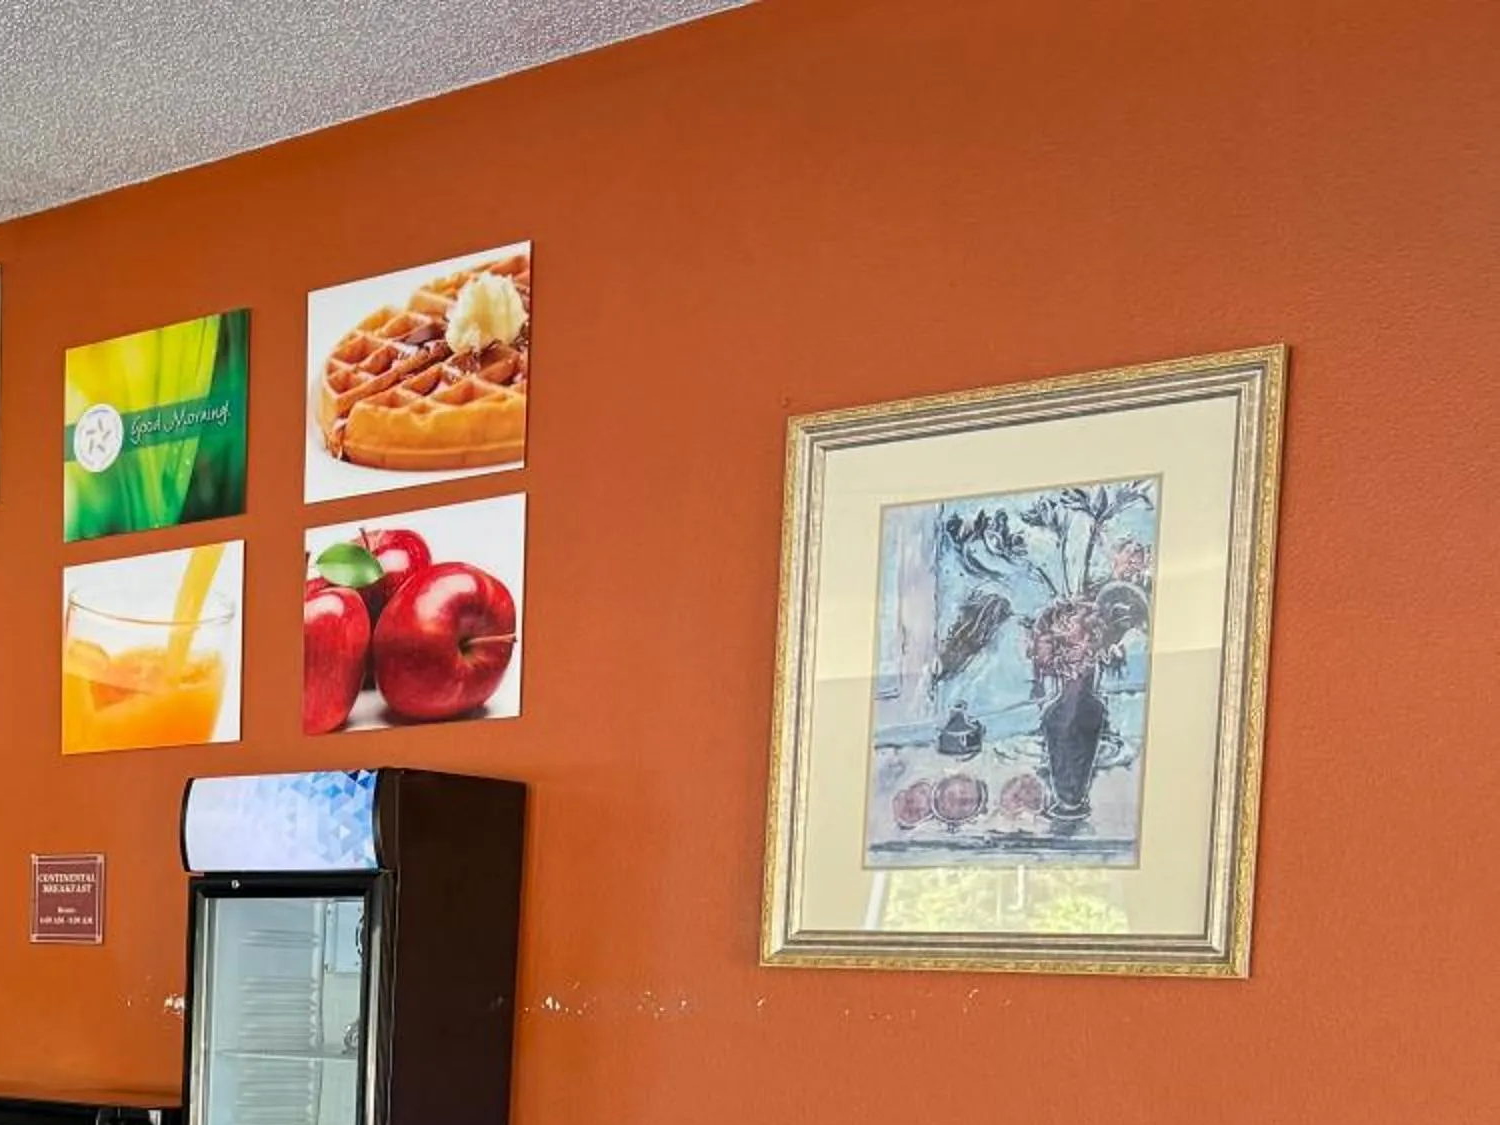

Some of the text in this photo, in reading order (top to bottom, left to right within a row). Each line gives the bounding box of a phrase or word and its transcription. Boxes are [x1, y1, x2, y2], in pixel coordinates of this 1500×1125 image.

[130, 412, 161, 445] Good
[39, 873, 96, 882] CONTINENTAL
[42, 883, 92, 893] BREAKFAST
